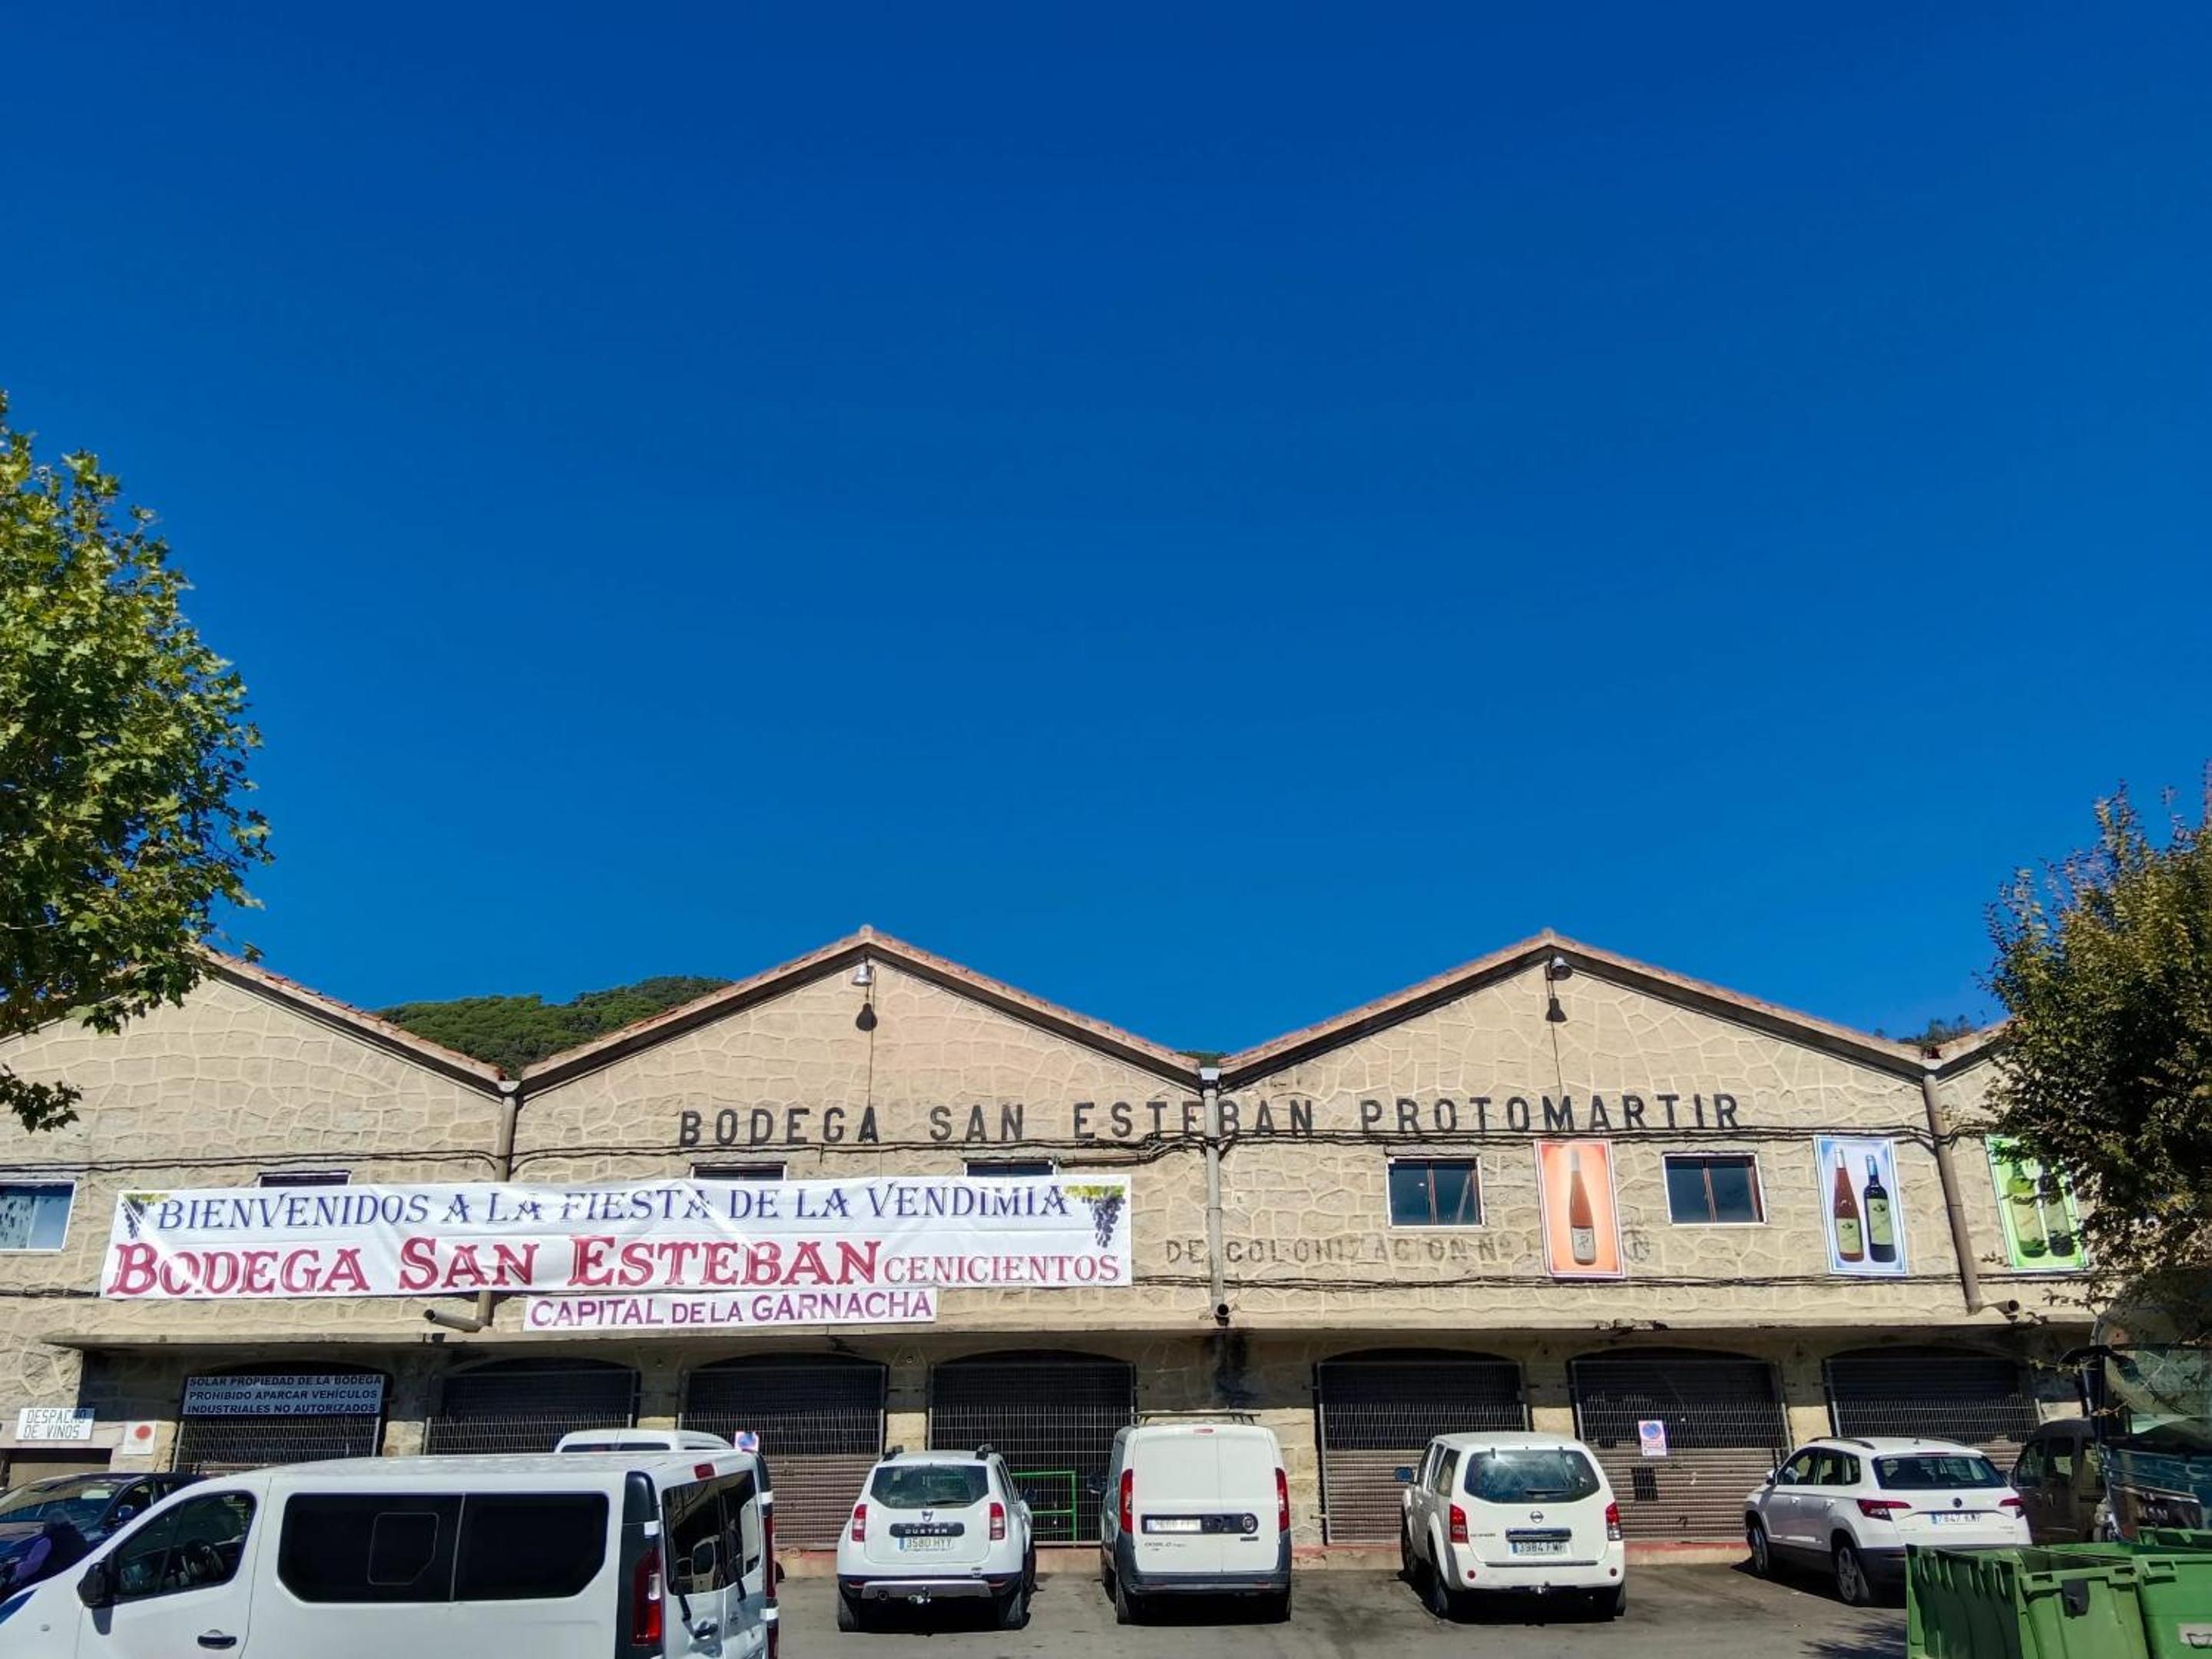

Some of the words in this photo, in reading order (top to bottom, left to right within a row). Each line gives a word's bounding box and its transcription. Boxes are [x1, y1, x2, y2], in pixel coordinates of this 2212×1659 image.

[679, 1107, 879, 1145] BODEGA
[929, 1104, 1023, 1142] SAN
[1073, 1099, 1313, 1138] ESTEBAN
[1359, 1093, 1739, 1134] PROTOMARTIR
[158, 1192, 430, 1229] BIENVENIDOS
[440, 1193, 472, 1223] A
[487, 1192, 541, 1222] LA
[560, 1189, 710, 1221] FIESTA
[730, 1189, 779, 1219] DE
[796, 1187, 851, 1217] LA
[867, 1182, 1071, 1217] VENDIMIA
[107, 1243, 370, 1296] BODEGA
[399, 1237, 540, 1289] SAN
[567, 1235, 882, 1286] ESTEBAN
[884, 1254, 1120, 1283] CENICIENTOS
[531, 1298, 664, 1327] CAPITAL
[752, 1291, 933, 1322] GARNACHA
[231, 1376, 294, 1386] PROPIEDAD
[299, 1376, 312, 1386] DE
[316, 1376, 330, 1386] LA
[189, 1390, 252, 1400] PROHIBIDO
[255, 1390, 308, 1399] APARCAR
[312, 1389, 377, 1399] VEHÍCULOS
[187, 1404, 271, 1414] INDUSTRIALES
[274, 1404, 290, 1413] NO
[293, 1402, 376, 1413] AUTORIZADOS
[26, 1409, 87, 1424] DESPACHO
[23, 1424, 38, 1439] DE
[46, 1424, 80, 1439] VINOS
